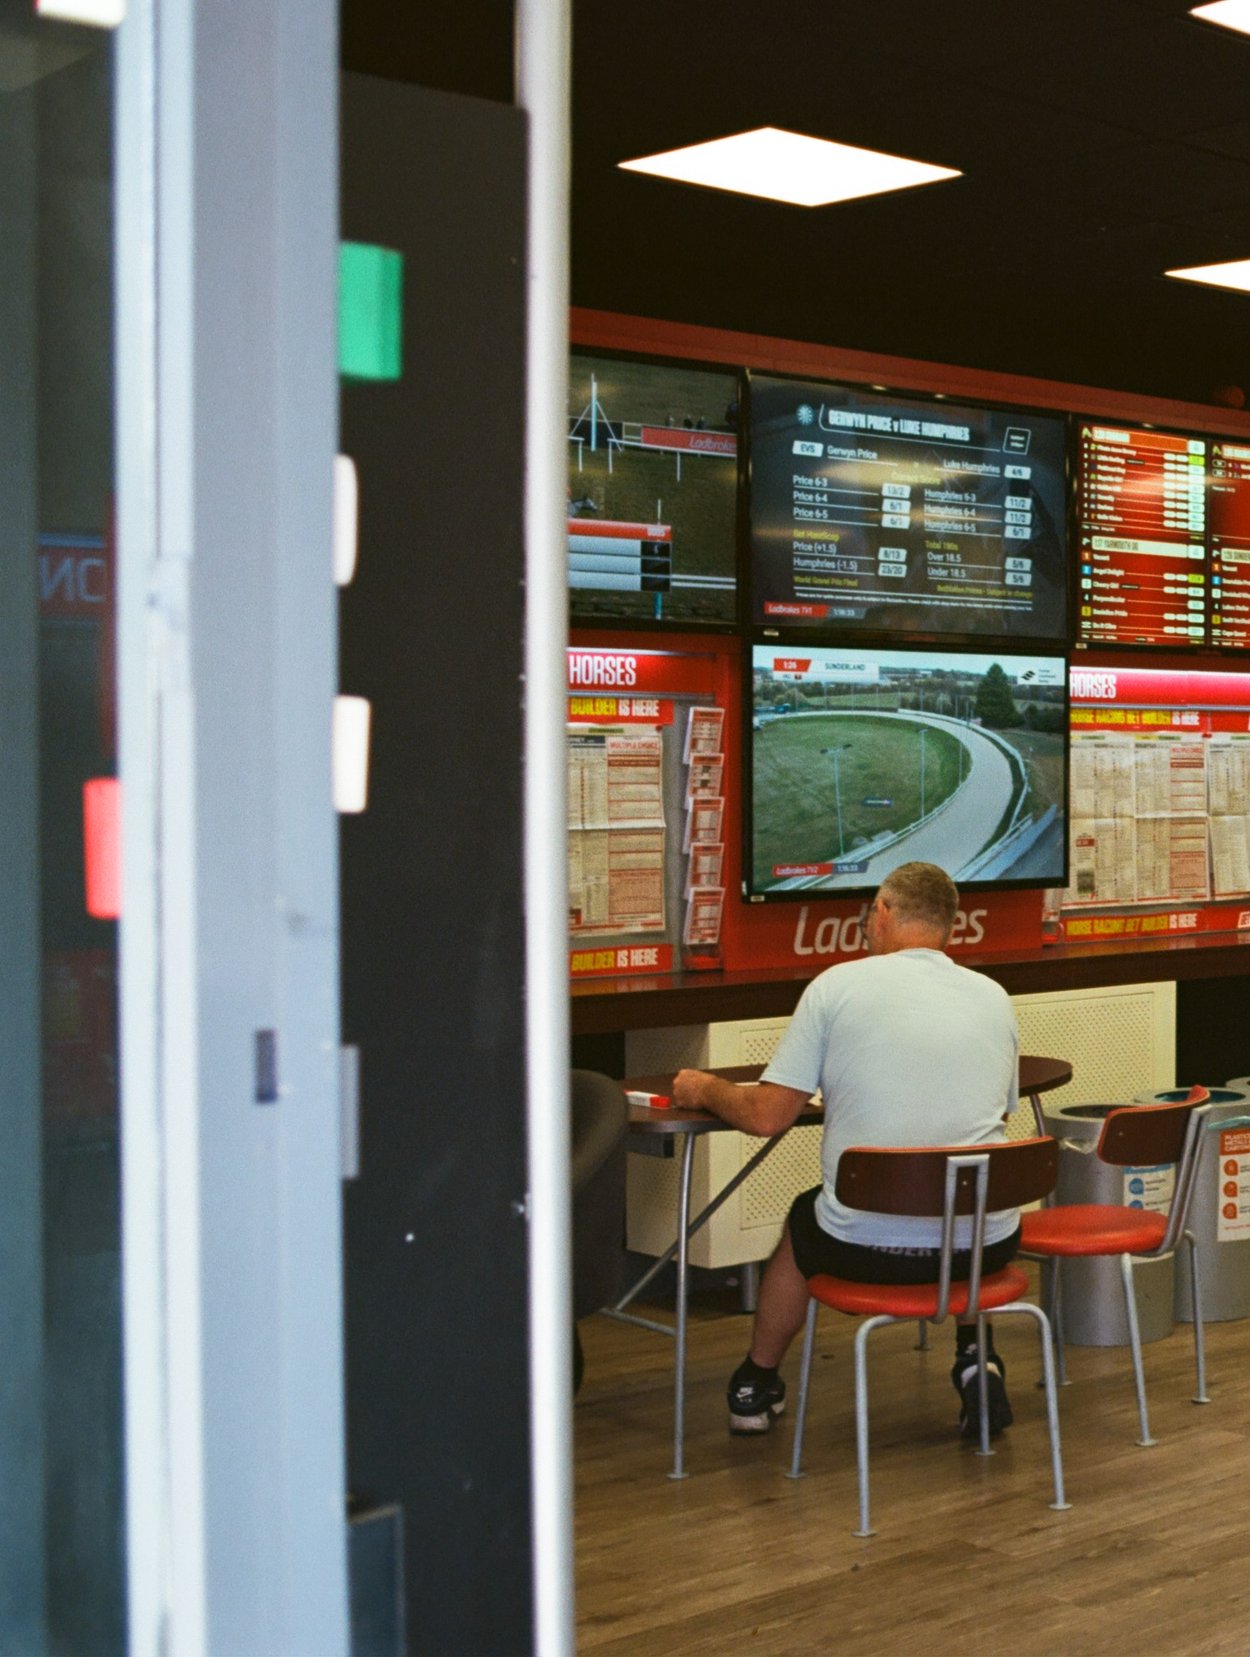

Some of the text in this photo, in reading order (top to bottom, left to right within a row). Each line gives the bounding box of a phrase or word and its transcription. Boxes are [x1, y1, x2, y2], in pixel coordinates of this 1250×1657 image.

[827, 445, 878, 460] Gerwyn Price
[943, 458, 1001, 474] Luke Humphries
[793, 475, 828, 488] Price 6-3
[793, 491, 828, 503] Price 6-4
[924, 488, 976, 503] Humphries 6-3
[924, 503, 976, 517] Humphries 6-4
[1010, 499, 1026, 508] 11/2
[793, 507, 828, 519] Price 6-5
[1010, 513, 1026, 523] 11/2
[924, 519, 976, 533] Humphries 6-5
[793, 541, 837, 555] Price (+1.5)
[793, 557, 858, 572] Humphries (-1.5)
[927, 552, 962, 563] Over 18.5
[927, 567, 966, 578] Under 18.5
[568, 654, 637, 686] HORSES
[824, 662, 866, 671] SUNDERLAND
[1069, 672, 1117, 699] HORSES
[570, 697, 660, 717] BUILDER IS HERE
[793, 905, 988, 956] Lades
[571, 947, 659, 972] BUILDER IS HERE
